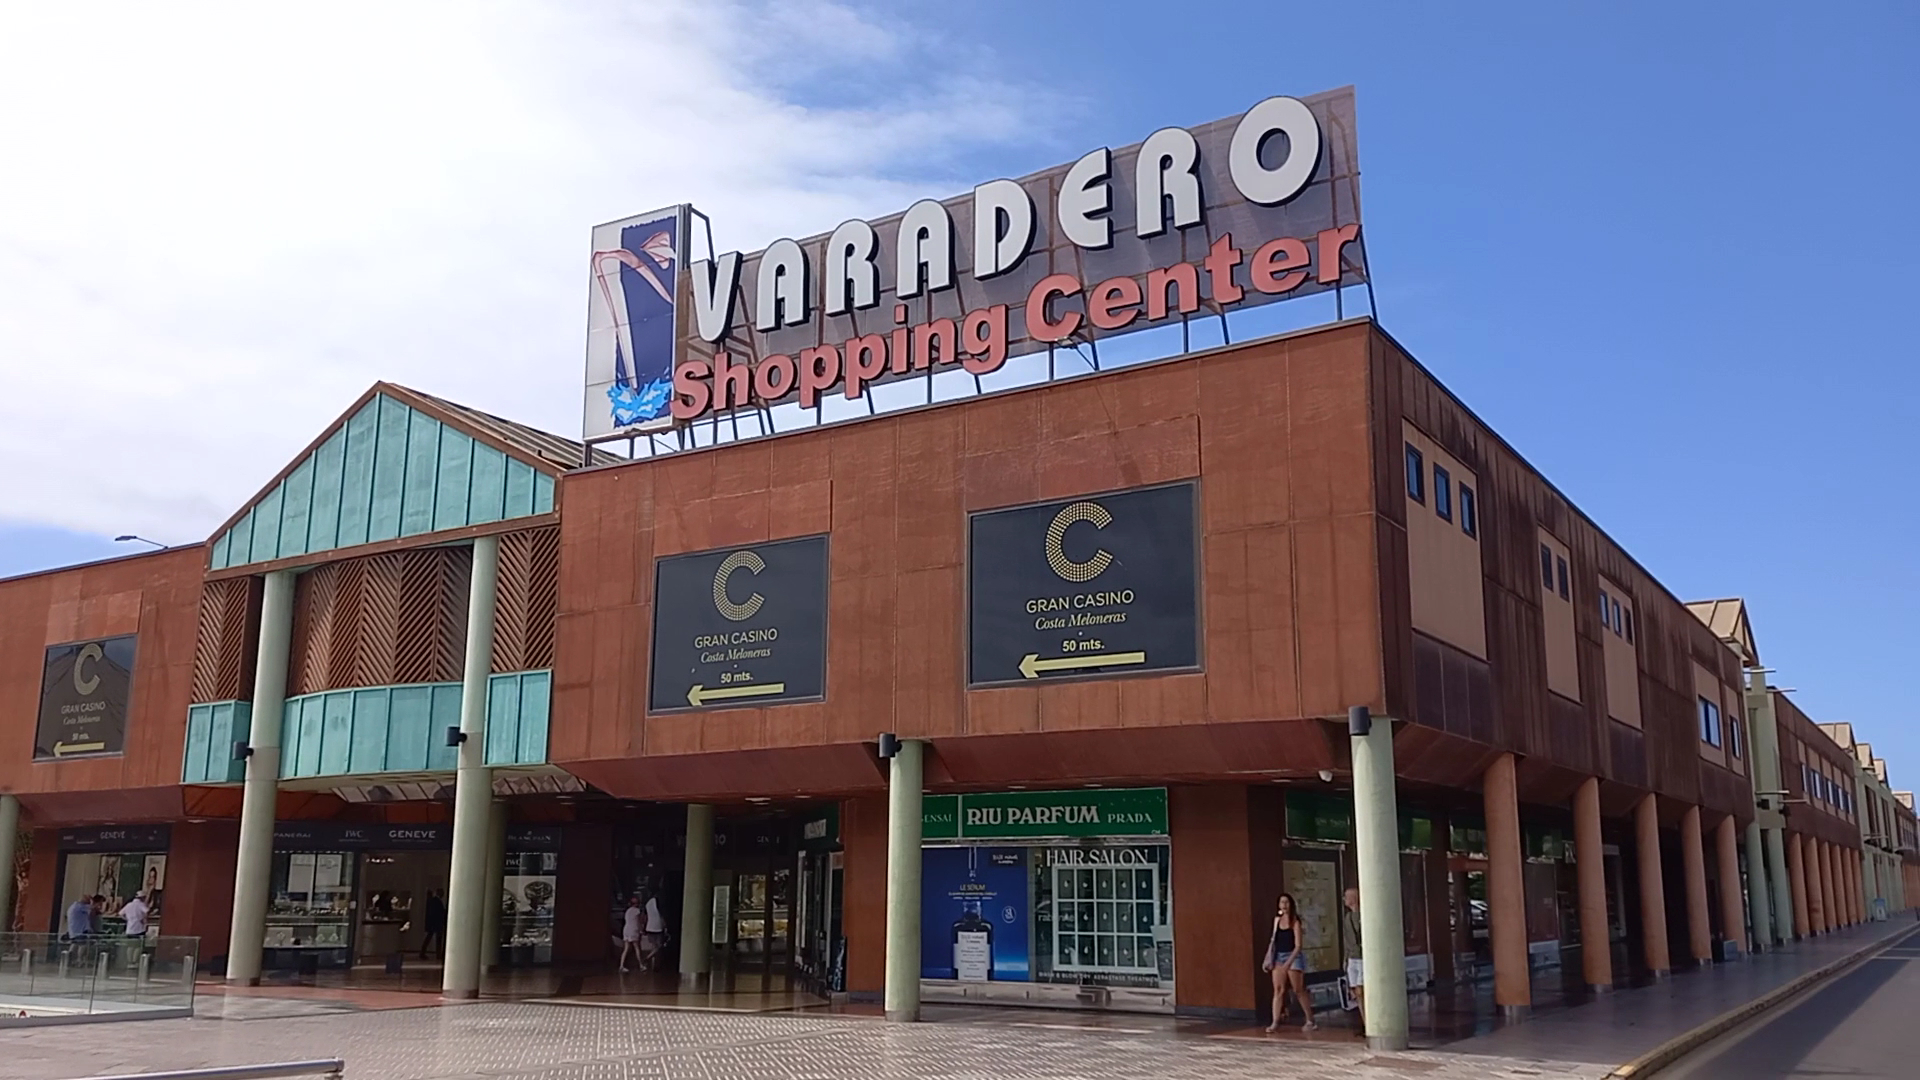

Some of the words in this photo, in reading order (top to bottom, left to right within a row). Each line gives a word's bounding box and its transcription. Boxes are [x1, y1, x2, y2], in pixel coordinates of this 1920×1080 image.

[690, 95, 1322, 344] VARADERO
[669, 303, 1009, 420] Shopping
[1025, 224, 1363, 343] Center
[1026, 596, 1070, 614] GRAN
[1073, 589, 1135, 609] CASINO
[1035, 616, 1066, 631] Costa
[1068, 611, 1128, 628] Meloneras
[694, 634, 729, 649] GRAN
[731, 628, 778, 645] CASINO
[1062, 639, 1077, 652] 50
[1079, 638, 1105, 651] mts.
[701, 651, 725, 664] Costa
[726, 647, 772, 662] Meloneras
[720, 672, 732, 684] 50
[733, 671, 754, 683] mts.
[61, 705, 80, 714] GRAN
[80, 701, 106, 712] CASINO
[921, 813, 952, 824] ENSAI
[966, 807, 1002, 826] RIU
[1007, 805, 1101, 825] PARFUM
[1107, 813, 1153, 824] PRADA
[99, 830, 126, 840] GENEVE
[344, 829, 365, 839] IWC
[388, 829, 437, 839] GENEVE
[1046, 849, 1086, 867] HAIR
[1088, 849, 1149, 867] SALON
